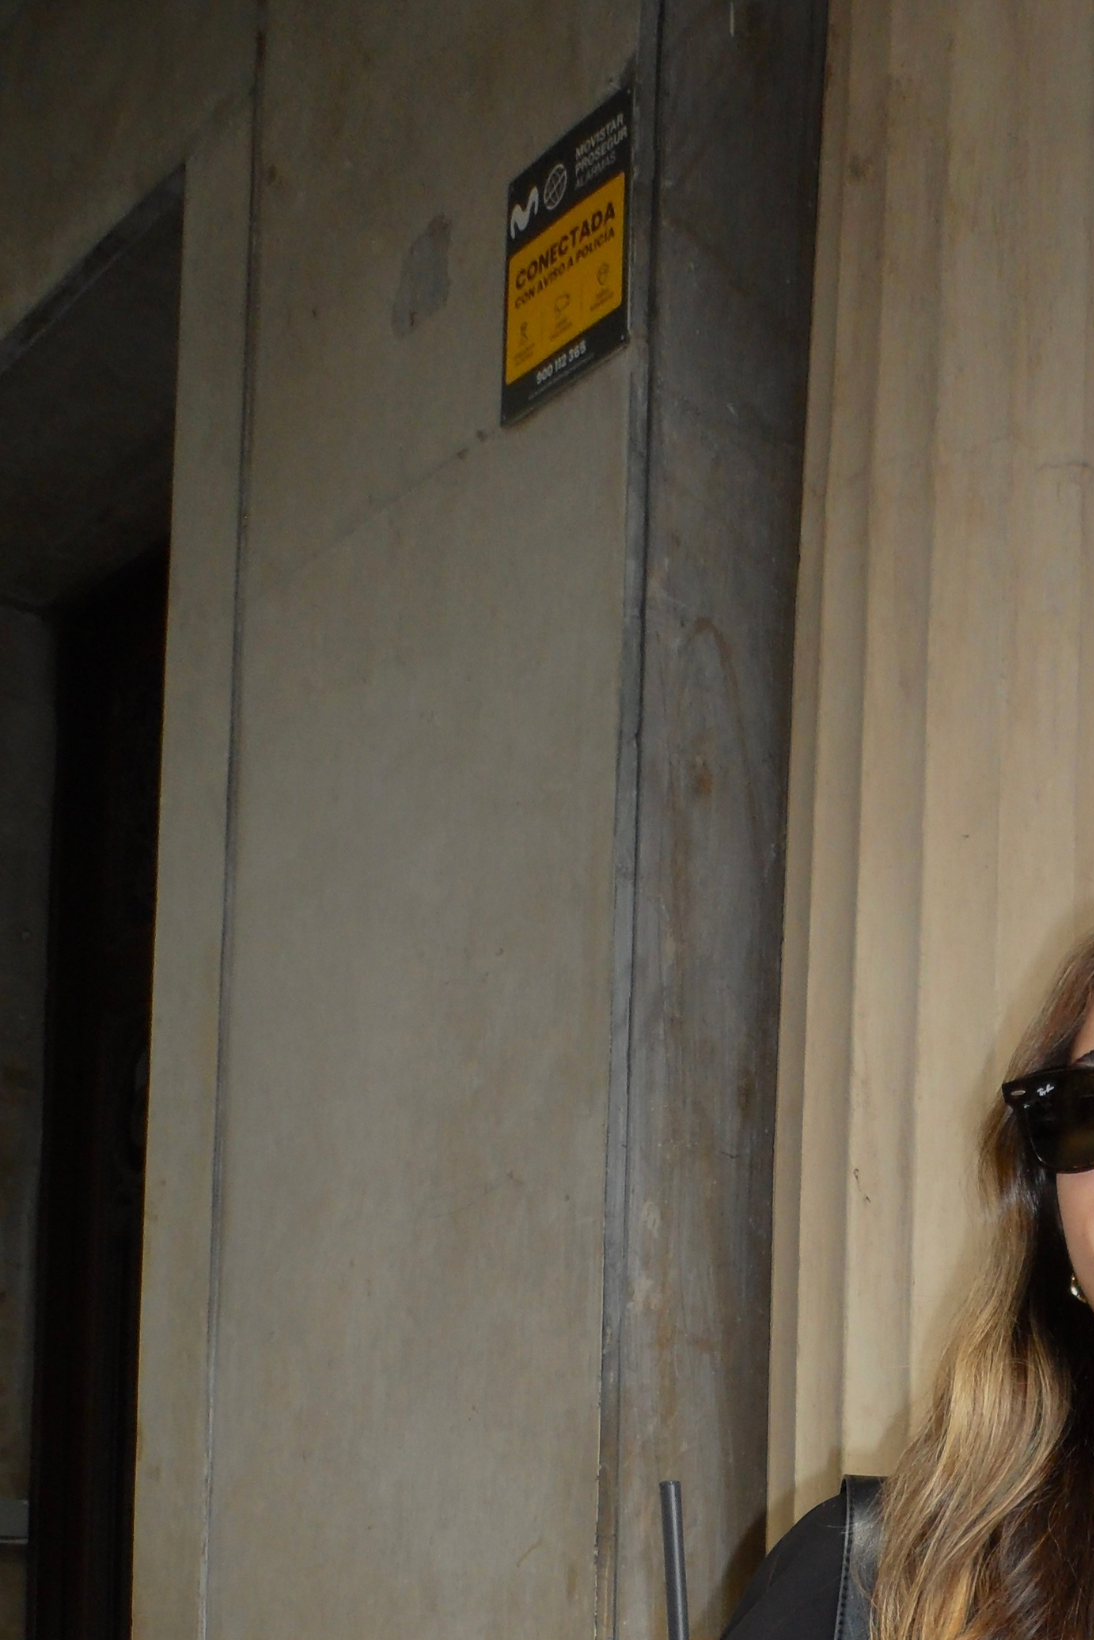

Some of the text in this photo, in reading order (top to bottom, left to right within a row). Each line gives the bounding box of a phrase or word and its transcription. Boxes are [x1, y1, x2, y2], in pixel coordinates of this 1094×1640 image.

[575, 113, 624, 160] MOVISTAR
[575, 126, 627, 177] PROSEGUR
[574, 150, 617, 190] ALARMAS
[515, 201, 616, 290] CONECTADA
[514, 285, 535, 309] CON
[536, 363, 554, 386] 900
[554, 353, 568, 373] 112
